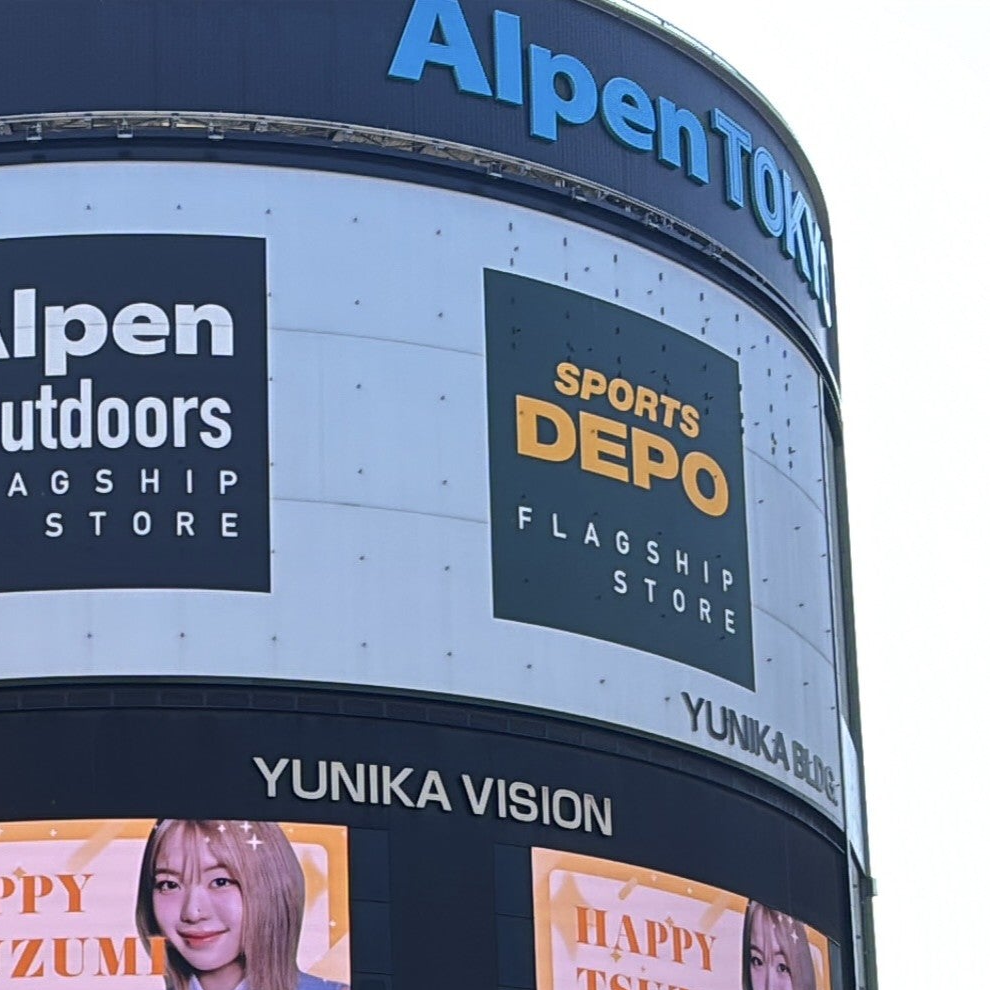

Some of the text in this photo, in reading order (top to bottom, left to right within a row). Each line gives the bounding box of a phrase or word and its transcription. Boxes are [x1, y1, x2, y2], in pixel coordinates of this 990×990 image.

[388, 0, 832, 329] Alpen TOKYO
[554, 362, 700, 438] SPORTS
[515, 394, 729, 517] DEPO
[45, 511, 238, 537] STORE
[518, 506, 733, 592] FLAGSHIP
[614, 570, 736, 634] STORE
[680, 691, 790, 772] YUNIKA
[253, 757, 613, 836] YUNIKA VISION
[575, 905, 716, 972] HAPPY
